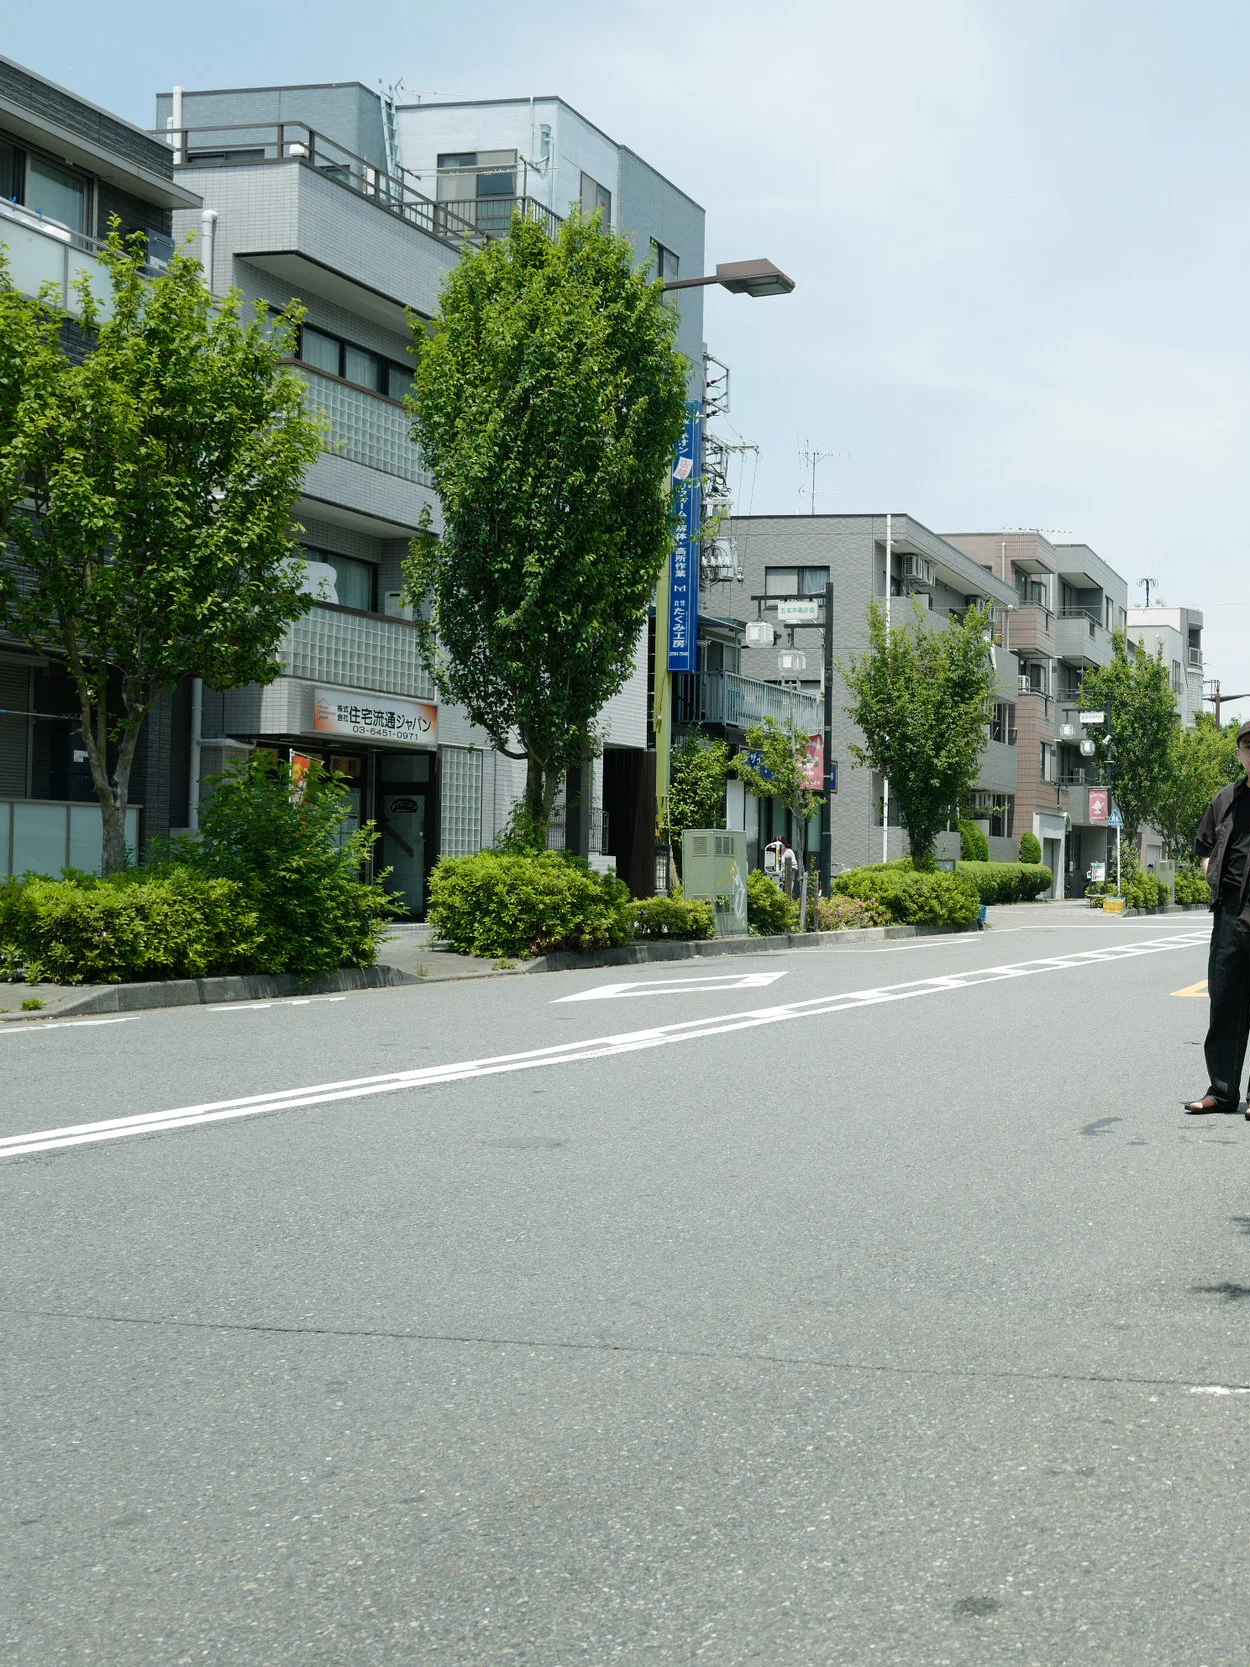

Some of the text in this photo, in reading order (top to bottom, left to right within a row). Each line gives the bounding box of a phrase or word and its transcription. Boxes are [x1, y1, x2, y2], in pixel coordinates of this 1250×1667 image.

[672, 607, 686, 648] たくみ工房
[349, 706, 432, 732] 住宅流通ジャパン
[352, 725, 418, 740] 03-6451-0971
